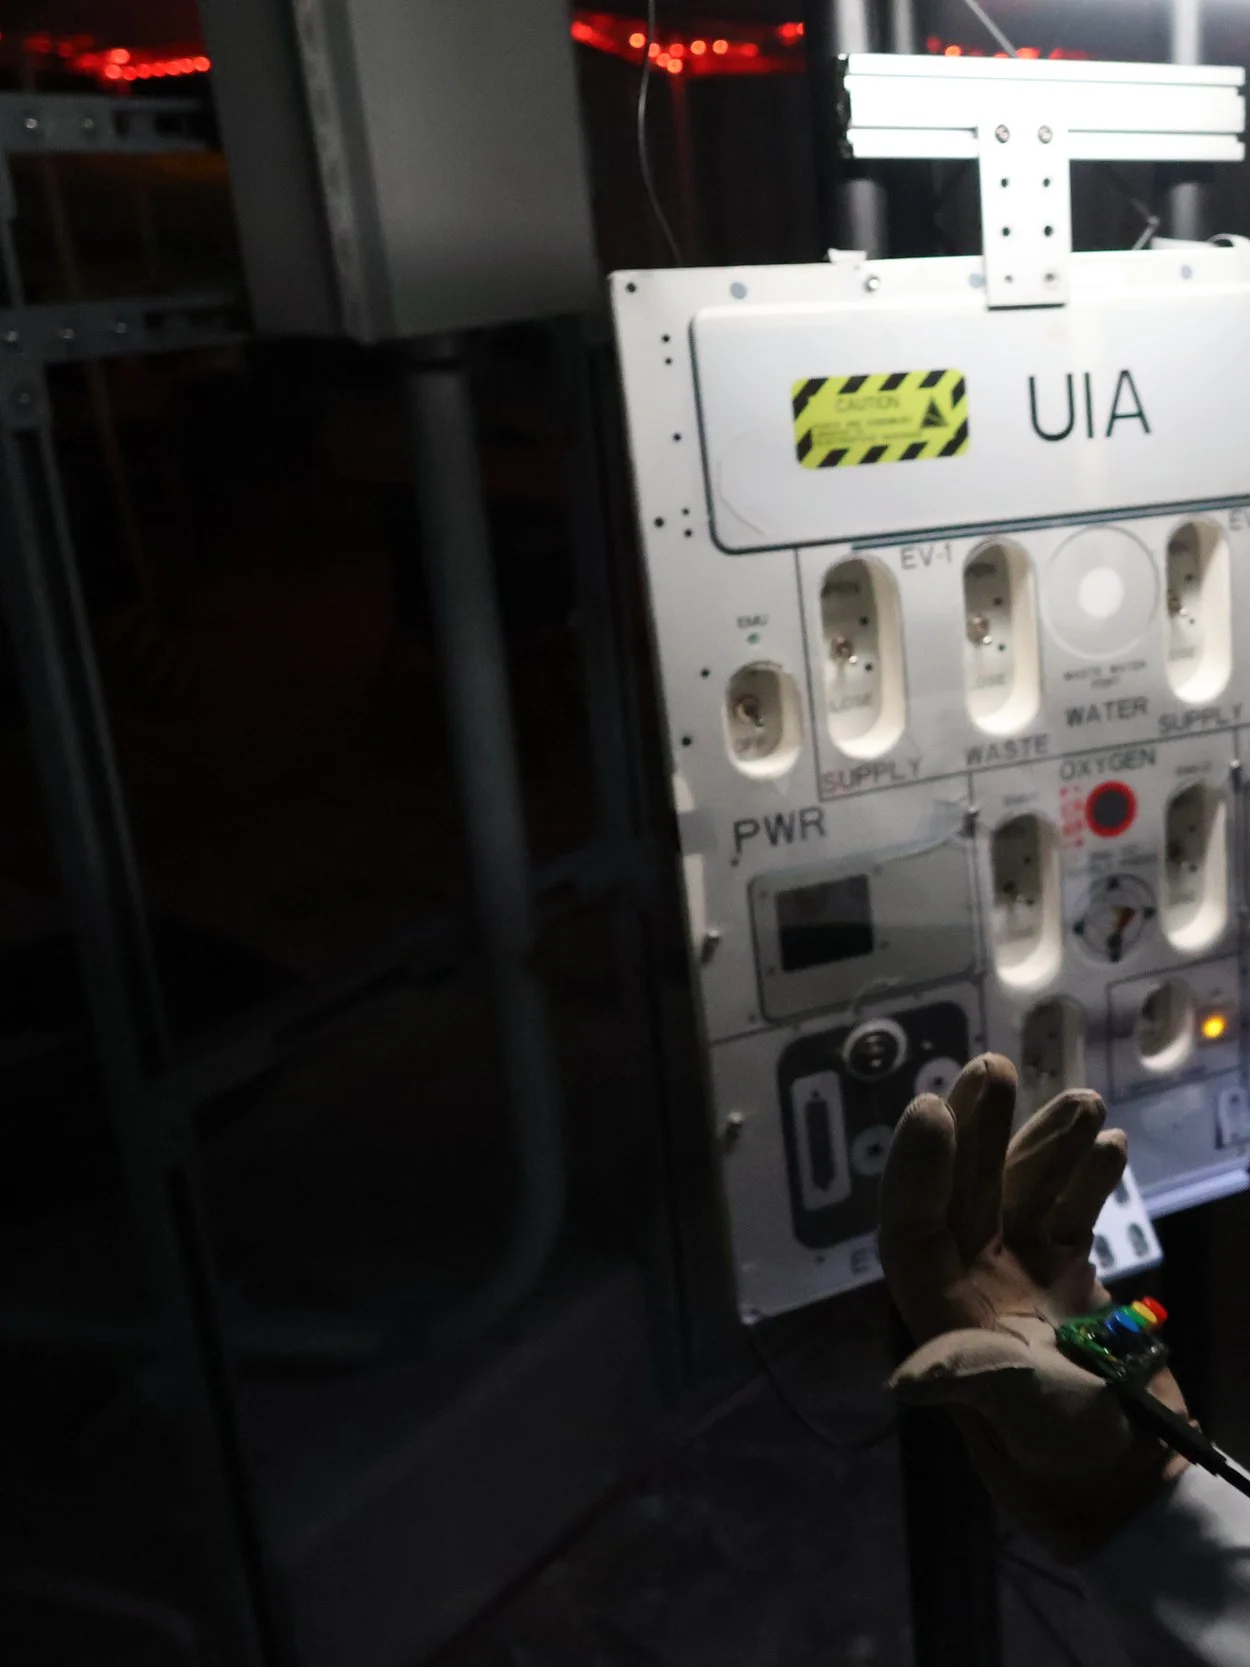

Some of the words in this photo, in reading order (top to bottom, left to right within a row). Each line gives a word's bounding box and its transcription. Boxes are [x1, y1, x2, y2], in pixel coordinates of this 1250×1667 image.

[836, 395, 899, 413] CAUTION
[1029, 369, 1152, 442] UIA
[900, 543, 952, 570] EV-1
[1064, 697, 1148, 728] WATER
[1158, 703, 1242, 735] SUPPLY
[966, 737, 1047, 767] WASTE
[1060, 747, 1156, 781] OXYGEN
[823, 757, 922, 796] SUPPLY
[733, 806, 826, 853] PWR
